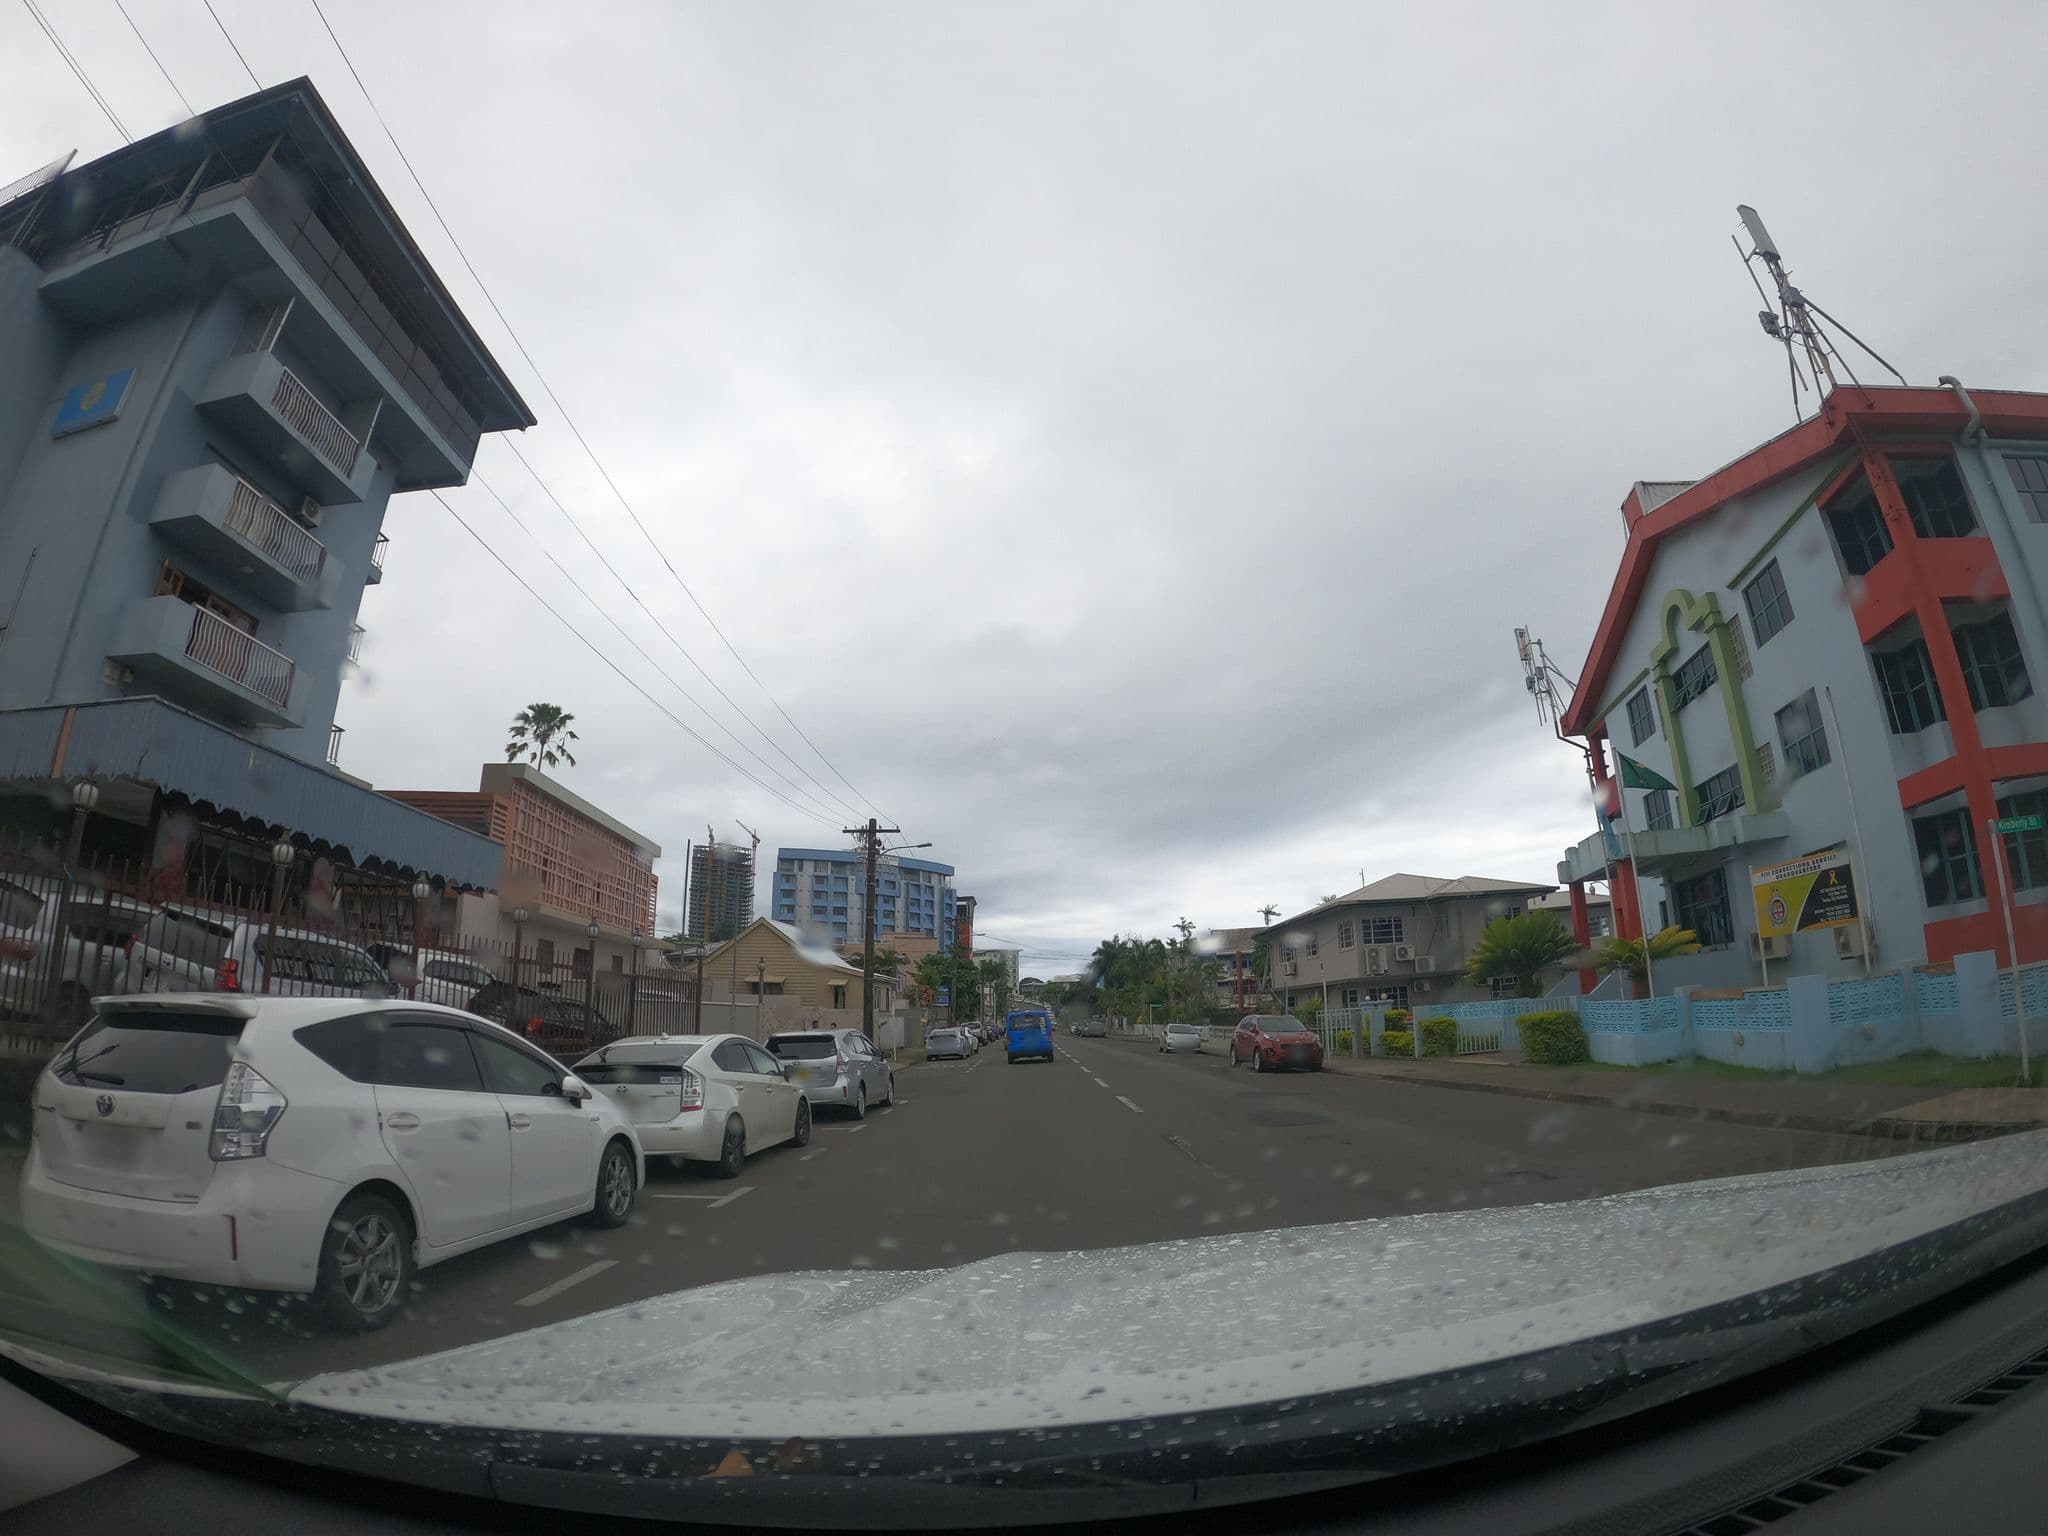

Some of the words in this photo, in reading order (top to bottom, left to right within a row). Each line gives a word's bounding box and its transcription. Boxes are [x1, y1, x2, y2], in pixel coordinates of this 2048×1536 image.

[1771, 861, 1810, 875] CORRECTIONS
[1812, 854, 1837, 865] SERVICE
[1775, 865, 1821, 880] HEADQUARTERS
